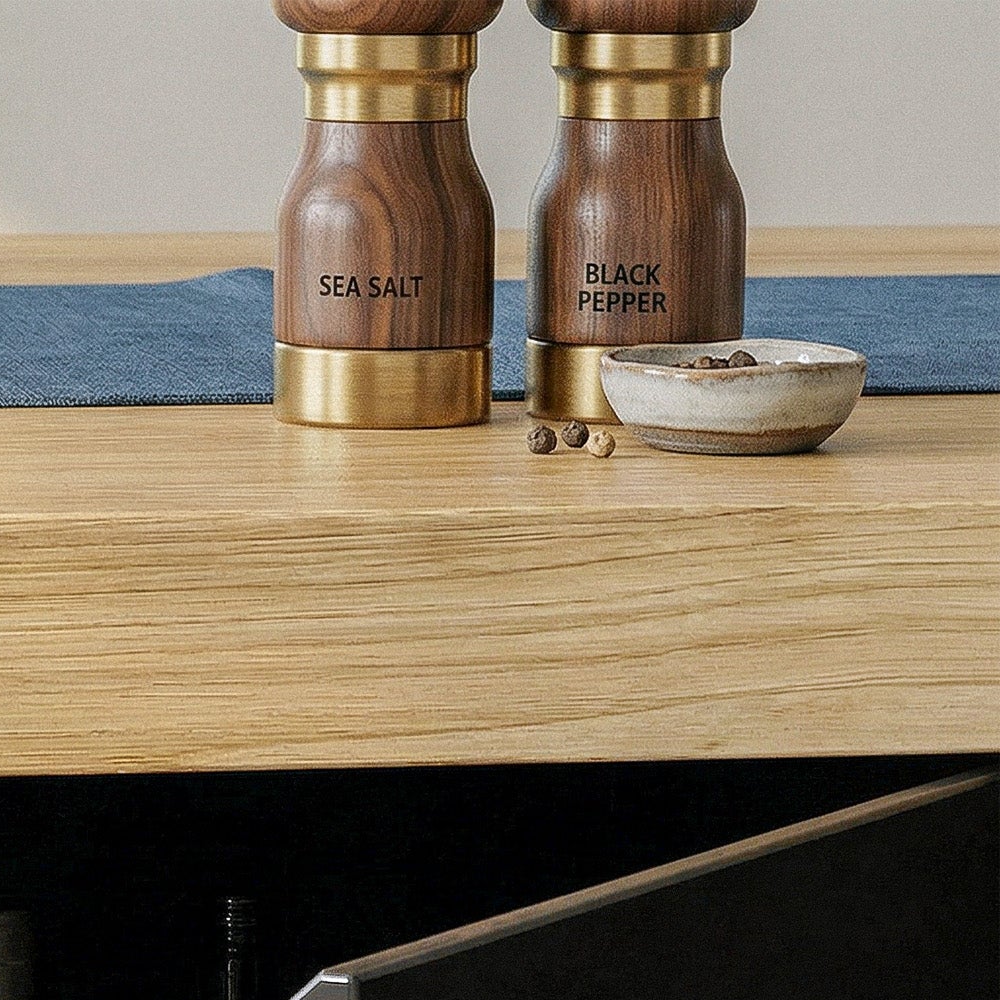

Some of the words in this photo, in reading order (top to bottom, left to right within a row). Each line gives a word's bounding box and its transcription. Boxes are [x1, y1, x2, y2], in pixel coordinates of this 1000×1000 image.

[585, 263, 661, 286] BLACK
[319, 275, 362, 298] SEA
[368, 275, 424, 298] SALT
[577, 290, 668, 313] PEPPER
